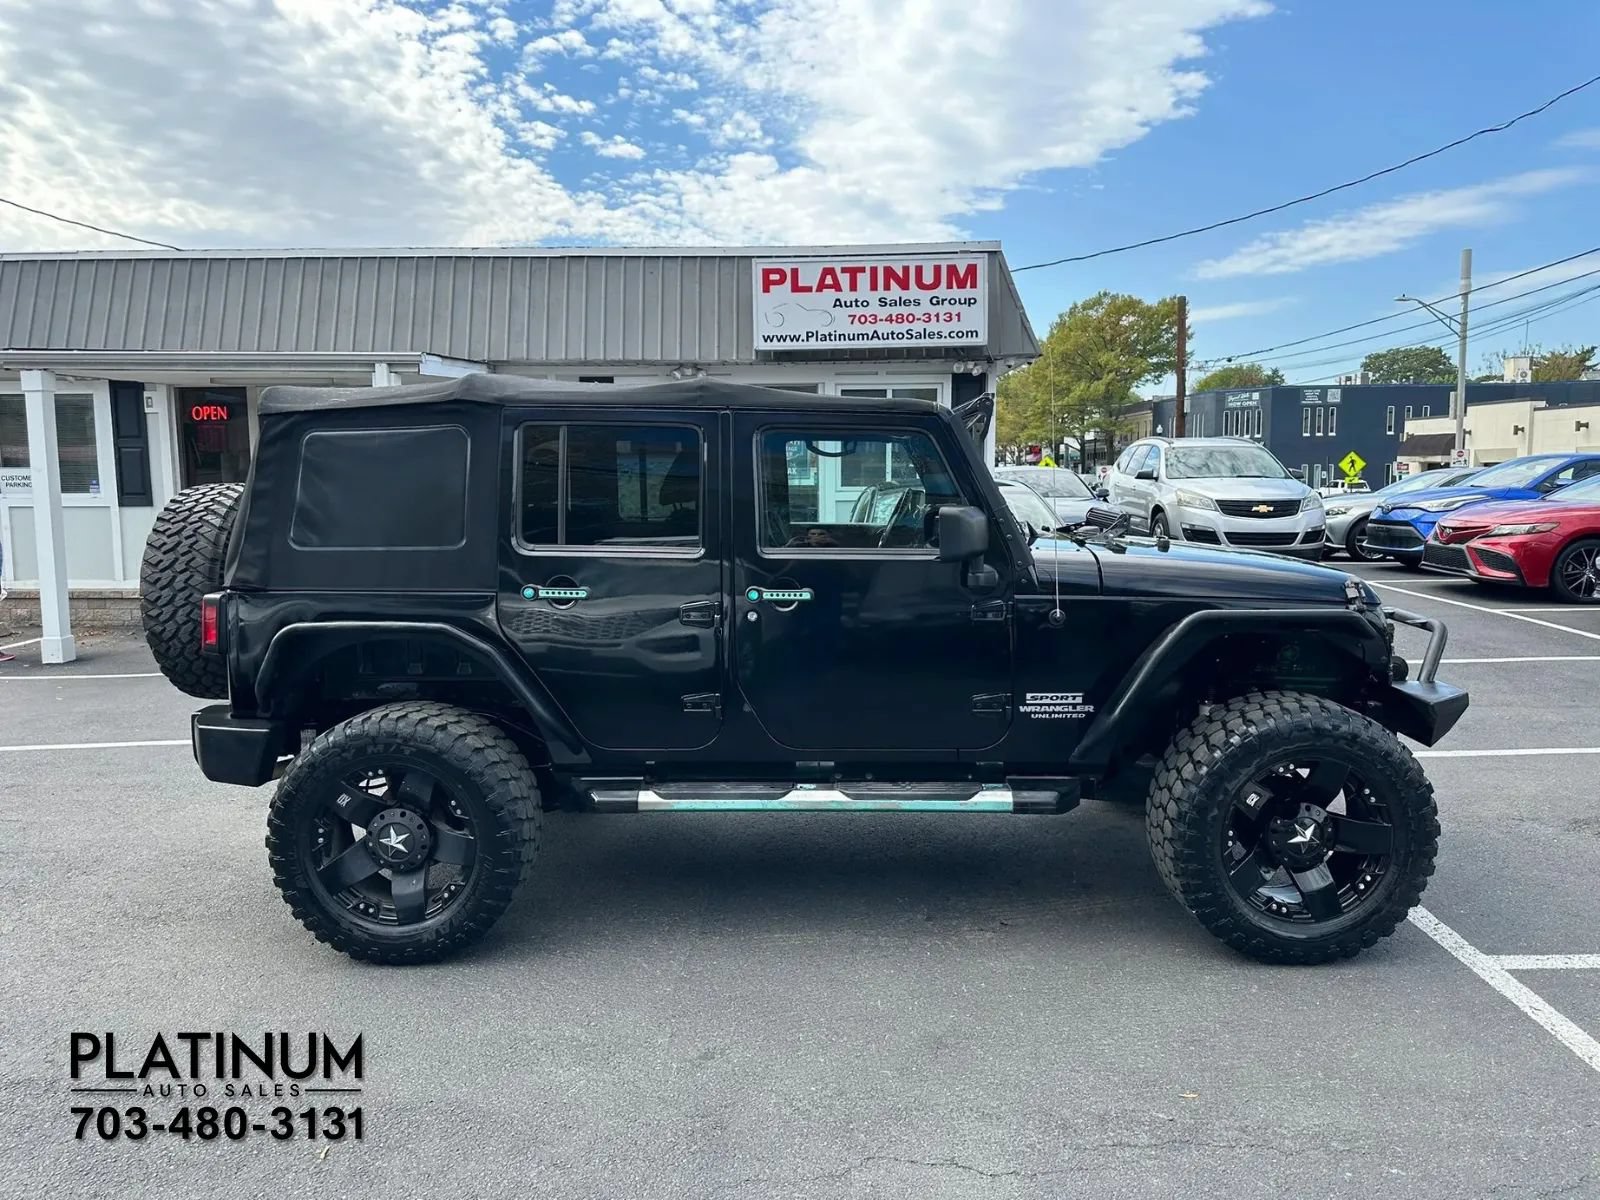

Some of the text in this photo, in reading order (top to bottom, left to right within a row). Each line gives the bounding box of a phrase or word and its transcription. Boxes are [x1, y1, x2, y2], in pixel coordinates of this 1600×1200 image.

[761, 263, 978, 293] PLATINUM
[832, 295, 978, 309] Auto Sales Group
[848, 311, 961, 325] 703-480-3131
[762, 328, 979, 343] www.PlatinumAutoSales.com
[191, 405, 228, 420] OPEN
[1027, 694, 1080, 702] SPORT
